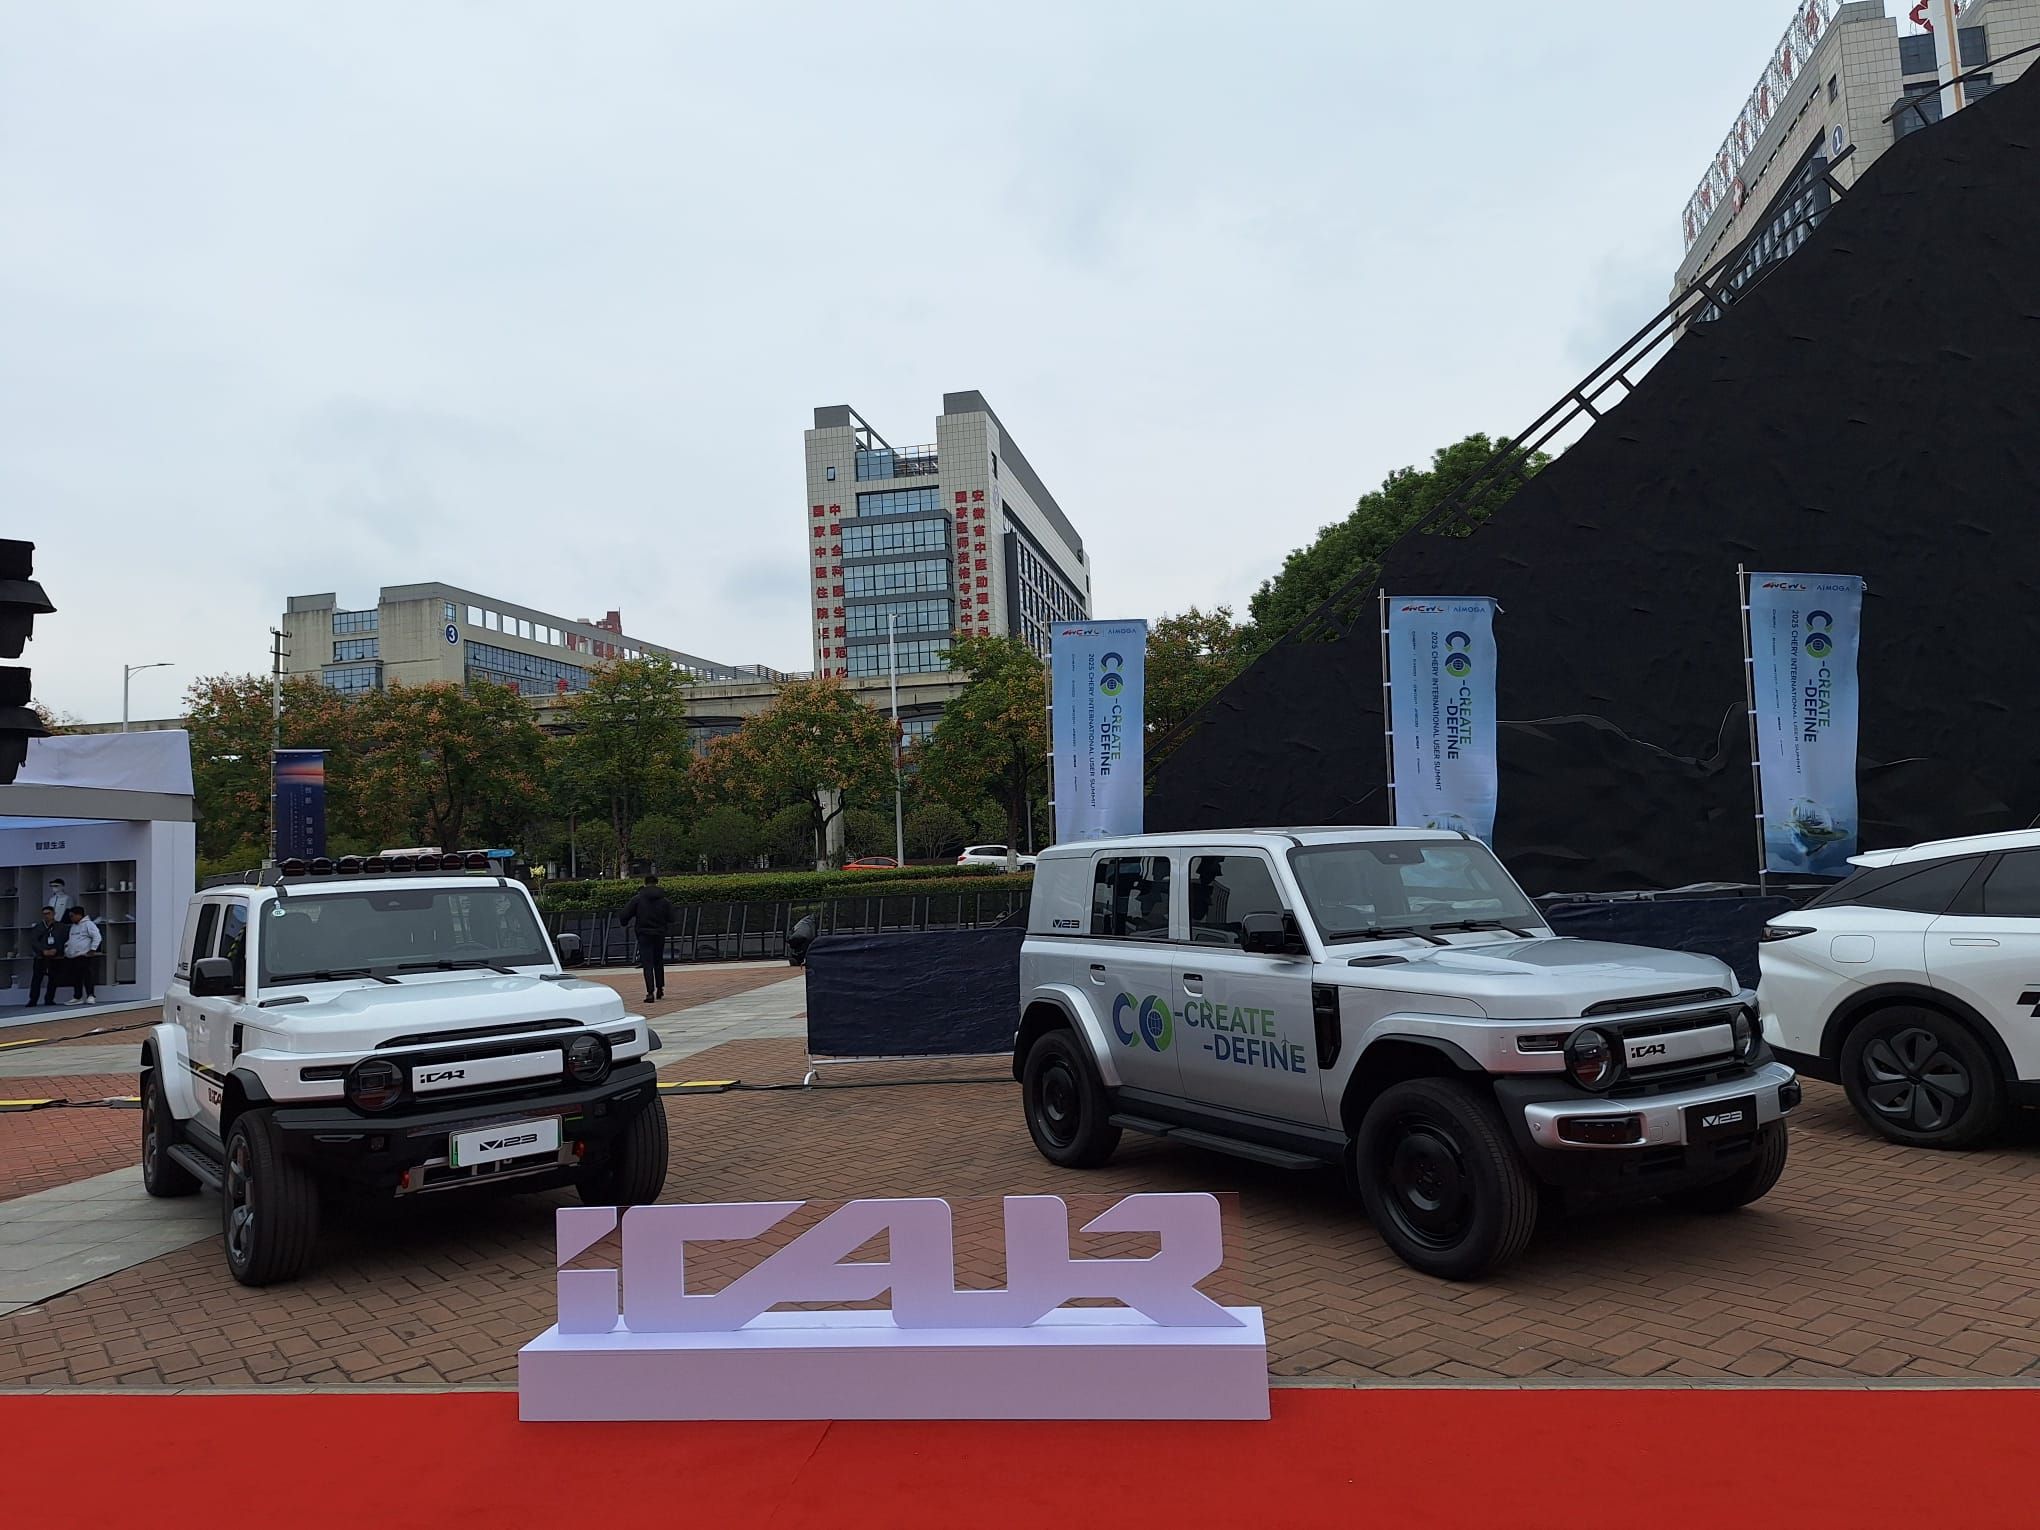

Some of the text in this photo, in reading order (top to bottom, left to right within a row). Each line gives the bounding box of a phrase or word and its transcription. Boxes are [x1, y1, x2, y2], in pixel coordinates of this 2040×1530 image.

[1791, 609, 1799, 628] 2025
[1790, 630, 1799, 656] CHERY
[1790, 658, 1799, 719] INTERNATIONAL
[1088, 697, 1096, 755] INTERNATIONAL
[1431, 631, 1442, 791] 2025 CHERY INTERNATIONAL USER SUMMIT
[1052, 919, 1080, 929] V23
